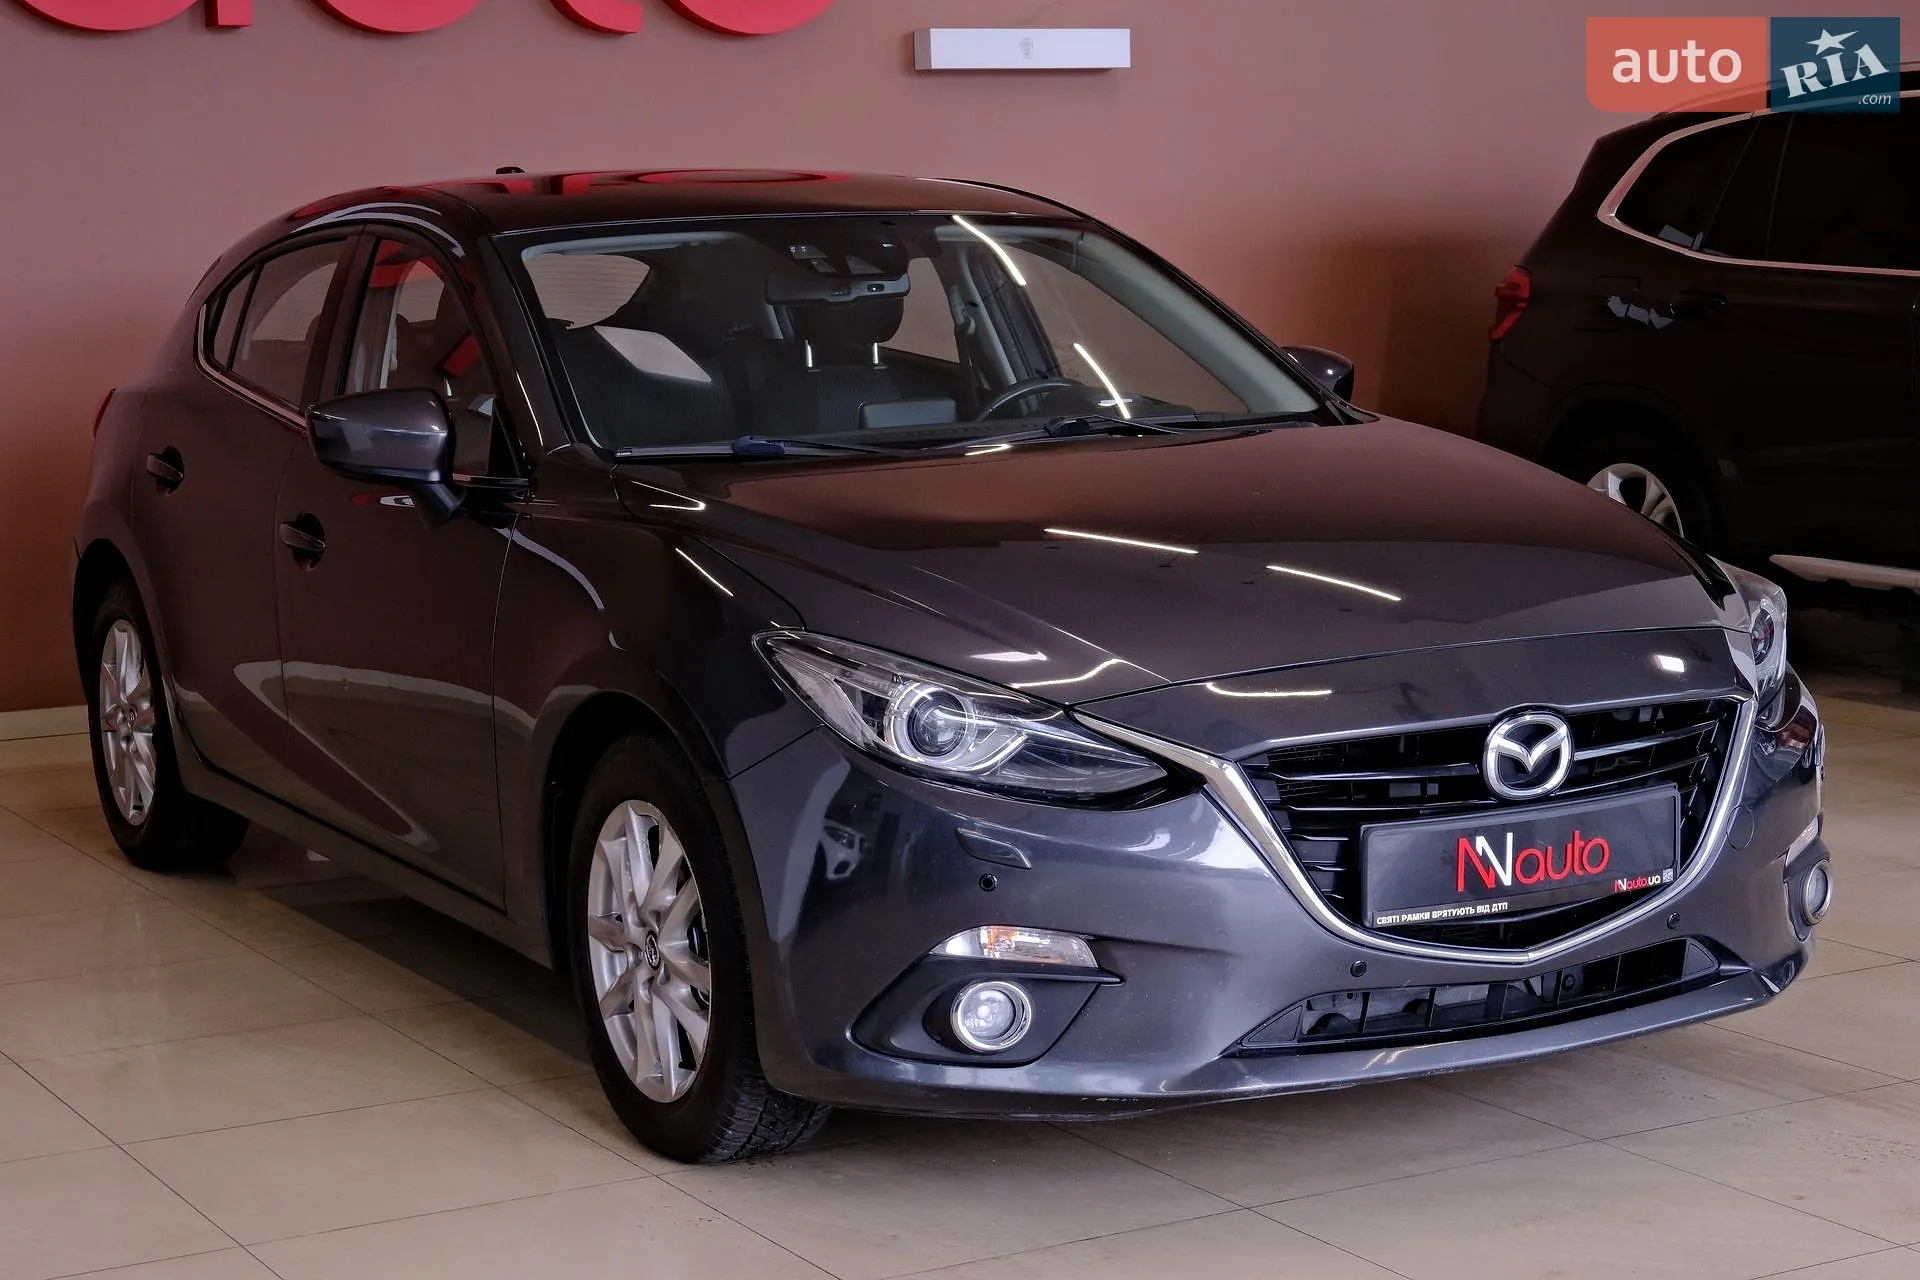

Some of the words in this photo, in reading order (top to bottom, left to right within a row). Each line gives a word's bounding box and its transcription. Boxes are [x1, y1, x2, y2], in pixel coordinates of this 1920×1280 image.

[1376, 916, 1400, 925] СВЯТІ
[1401, 912, 1430, 923] РАМКИ
[1431, 907, 1475, 919] ВРЯТУЮТЬ
[1476, 904, 1490, 914] ВІД
[1491, 902, 1508, 912] ДТП
